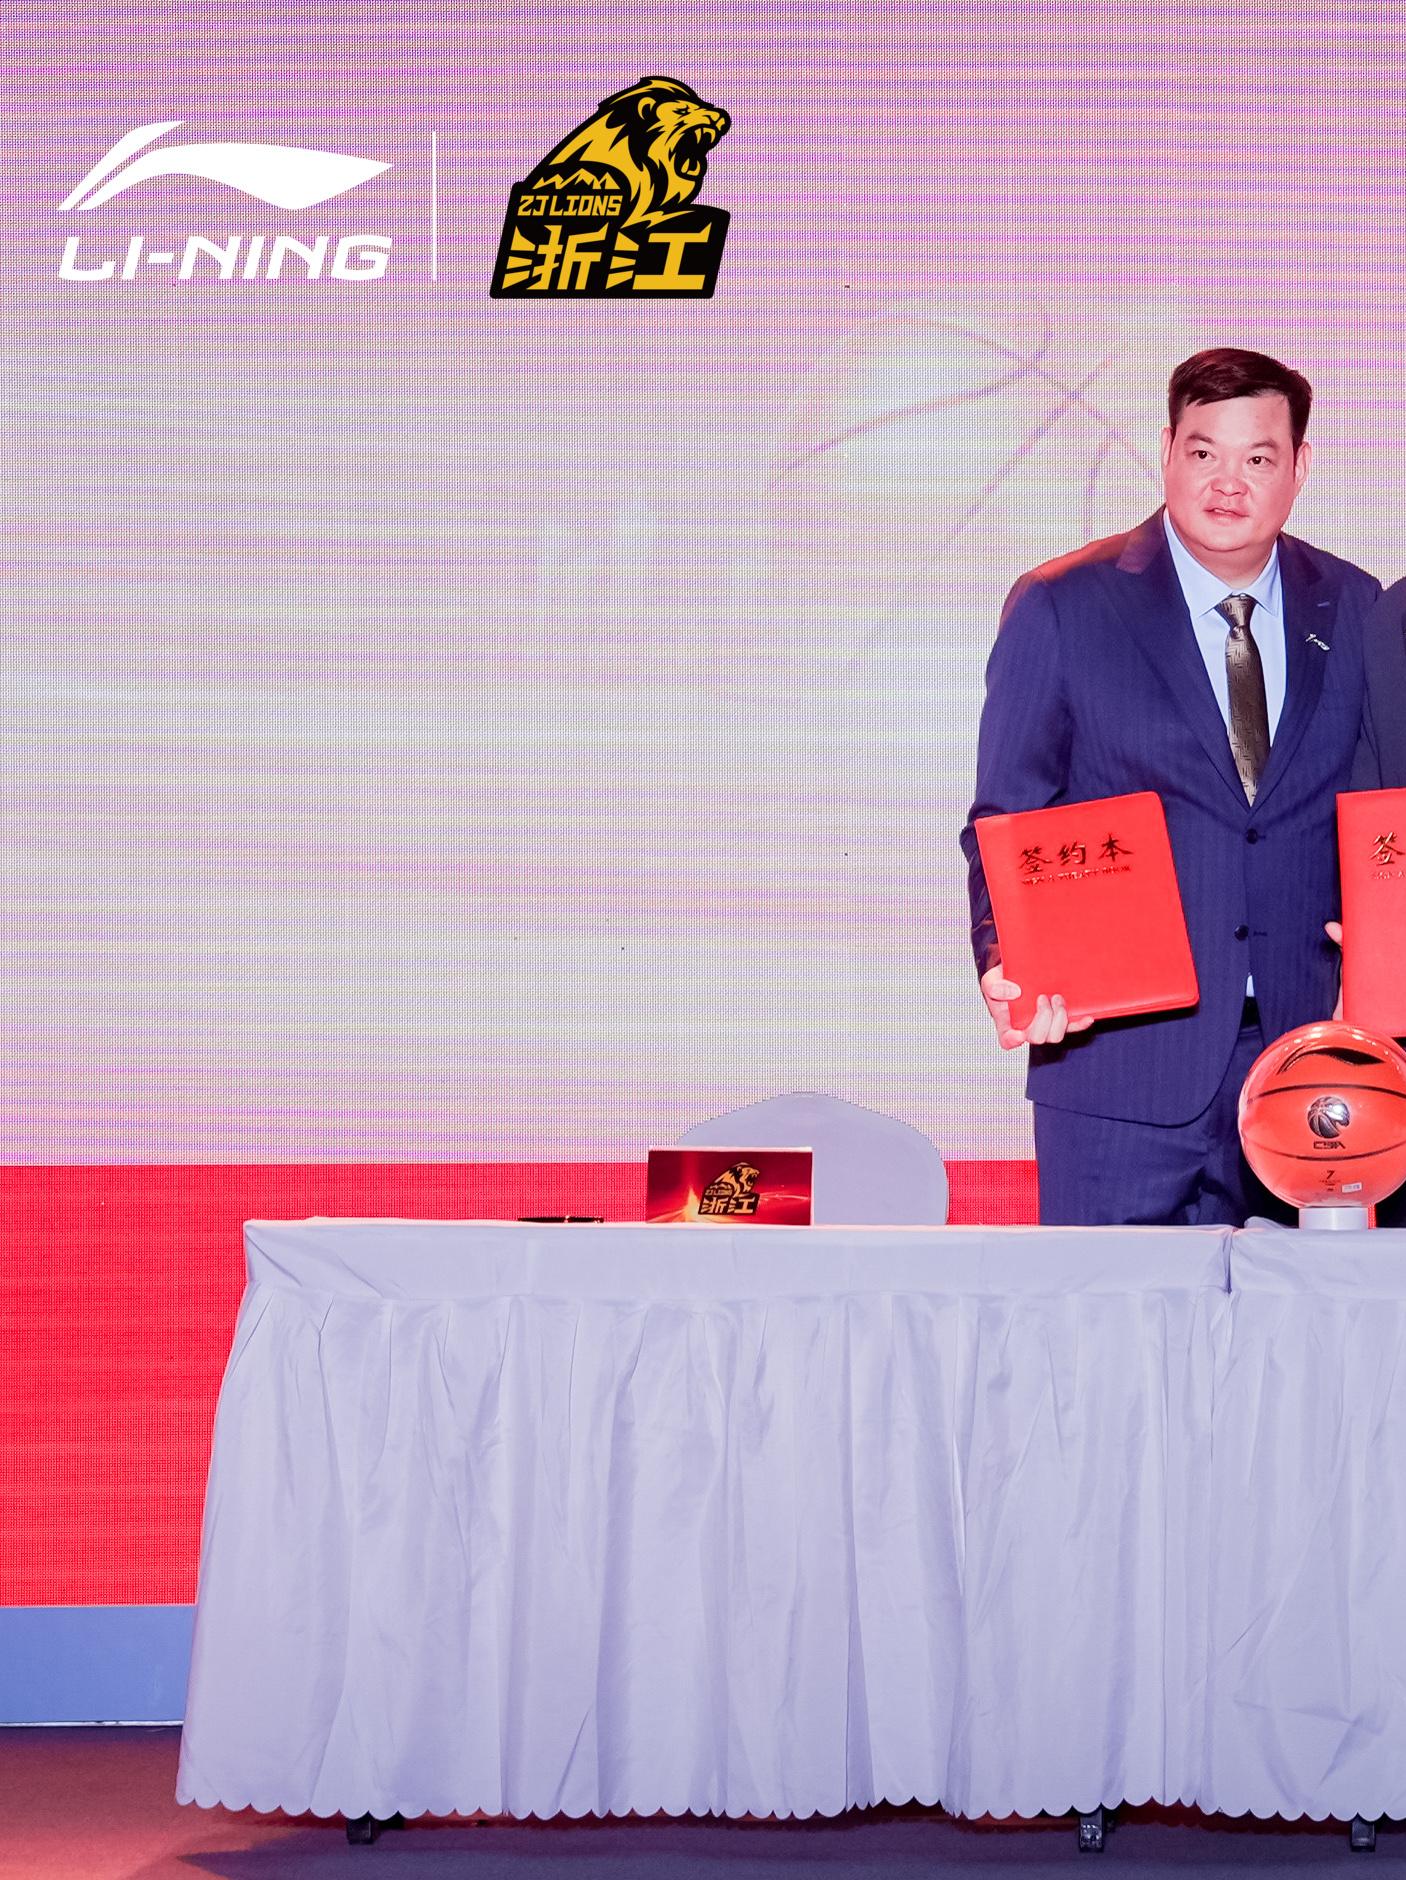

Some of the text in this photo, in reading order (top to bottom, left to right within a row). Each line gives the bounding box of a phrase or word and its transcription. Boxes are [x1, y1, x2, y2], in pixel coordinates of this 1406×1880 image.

[1018, 832, 1134, 875] 签约本
[700, 1196, 756, 1214] 浙江
